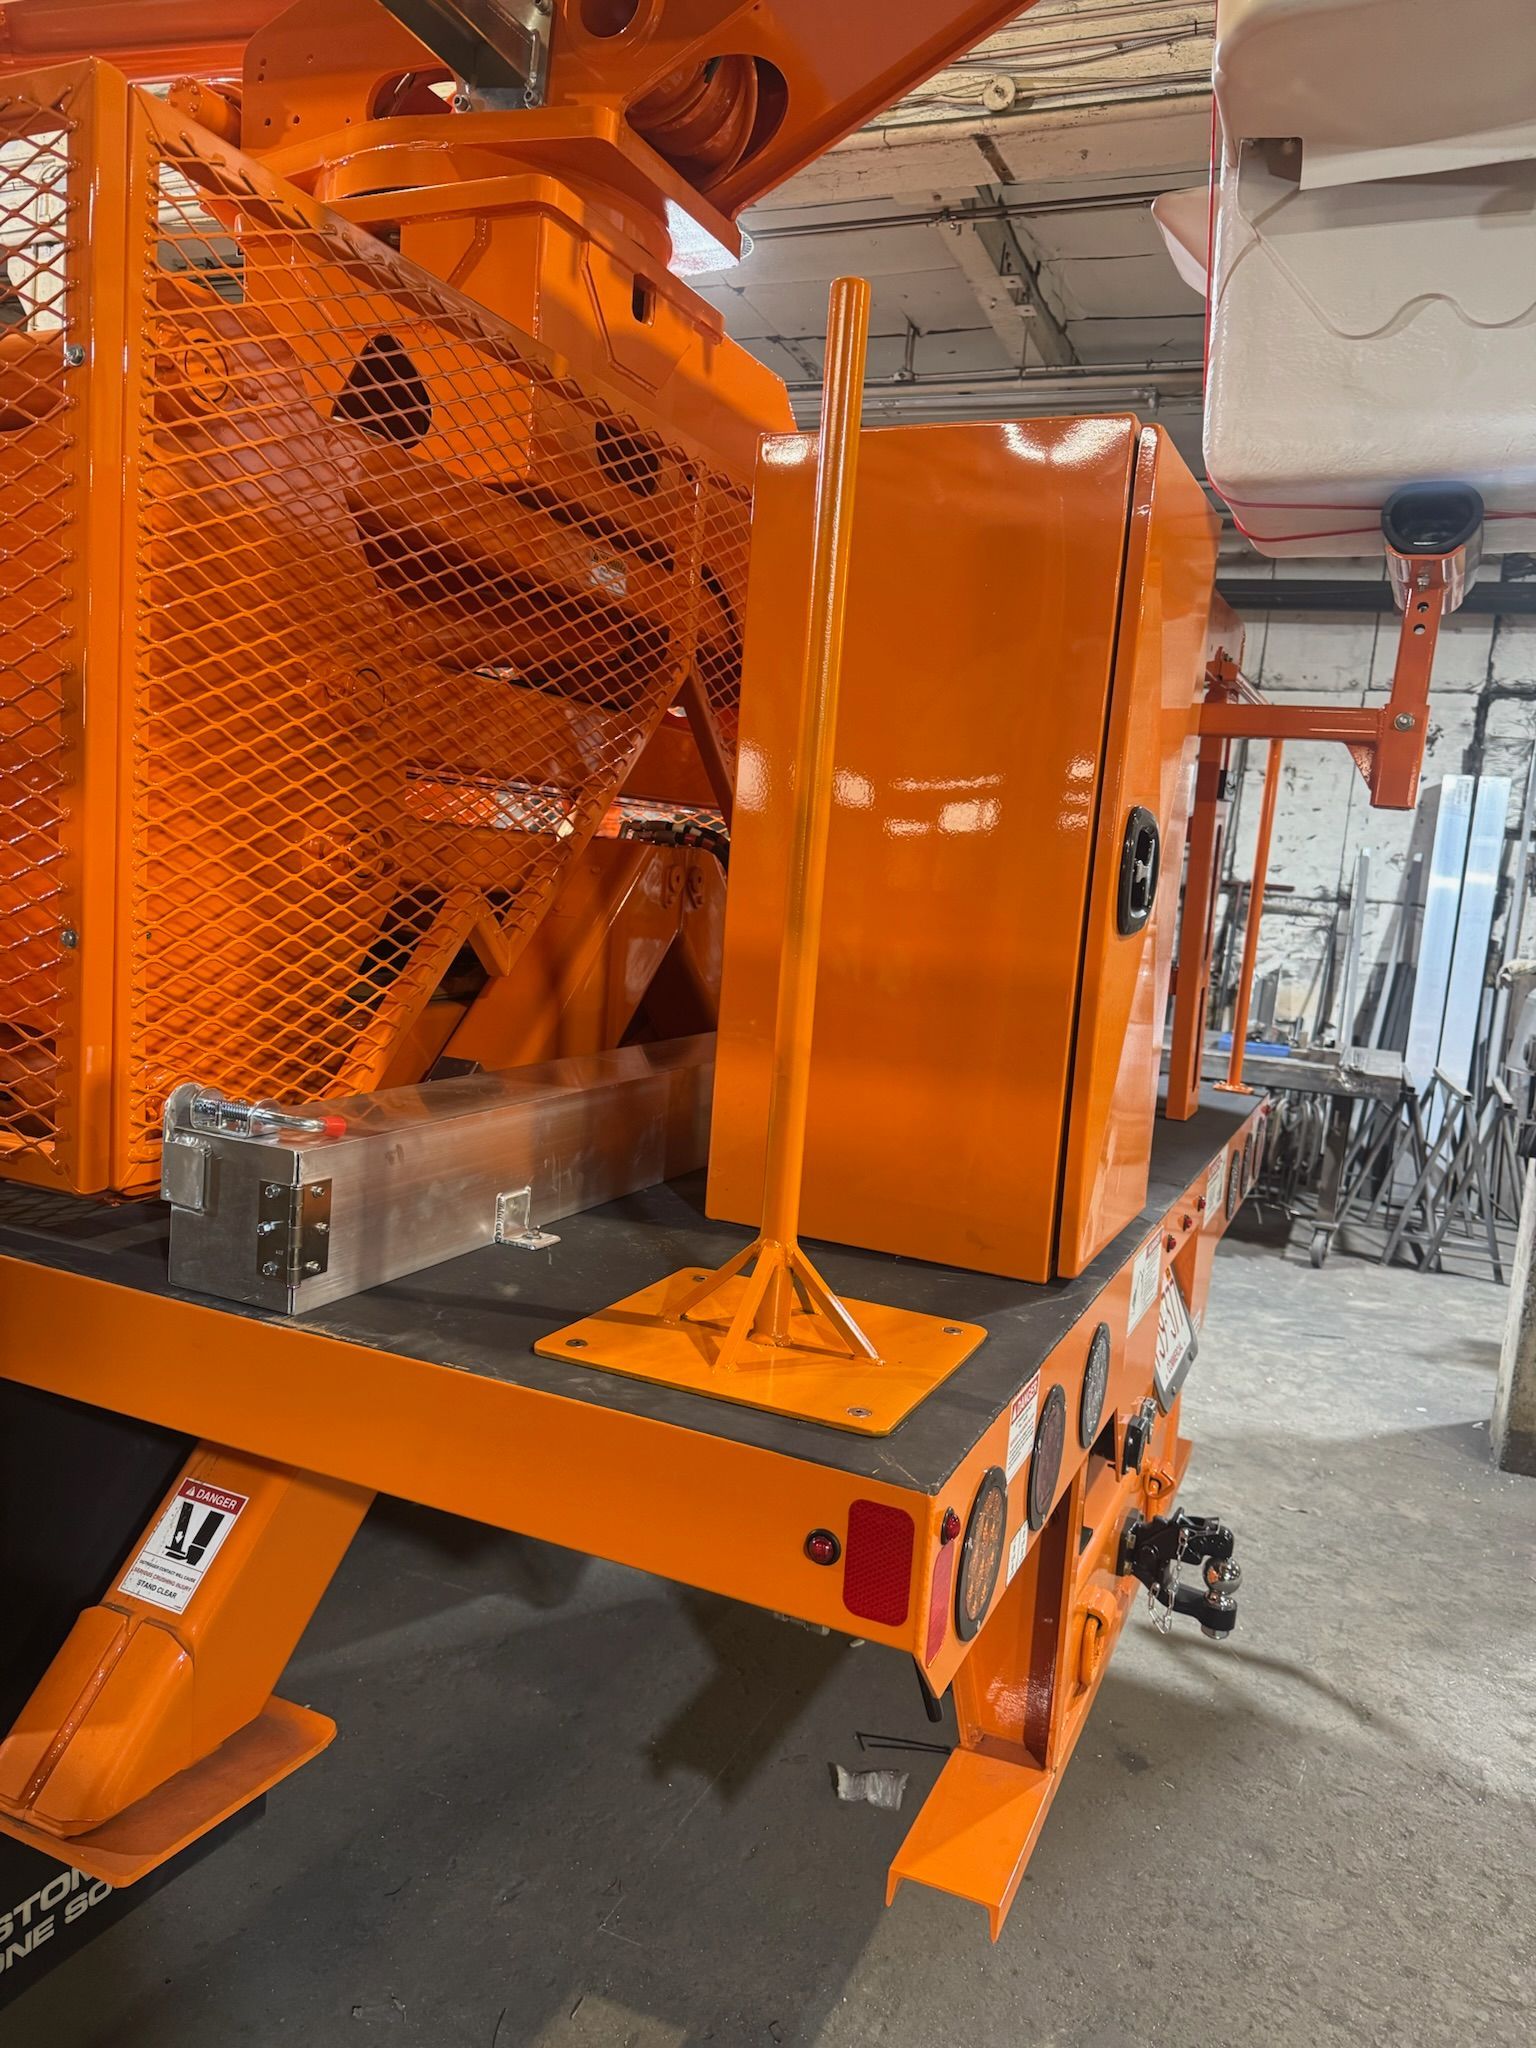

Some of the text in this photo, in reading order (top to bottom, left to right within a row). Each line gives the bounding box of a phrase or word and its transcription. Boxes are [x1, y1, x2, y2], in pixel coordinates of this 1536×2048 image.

[195, 1489, 238, 1510] DANGER
[137, 1579, 178, 1600] STAND CLEAR
